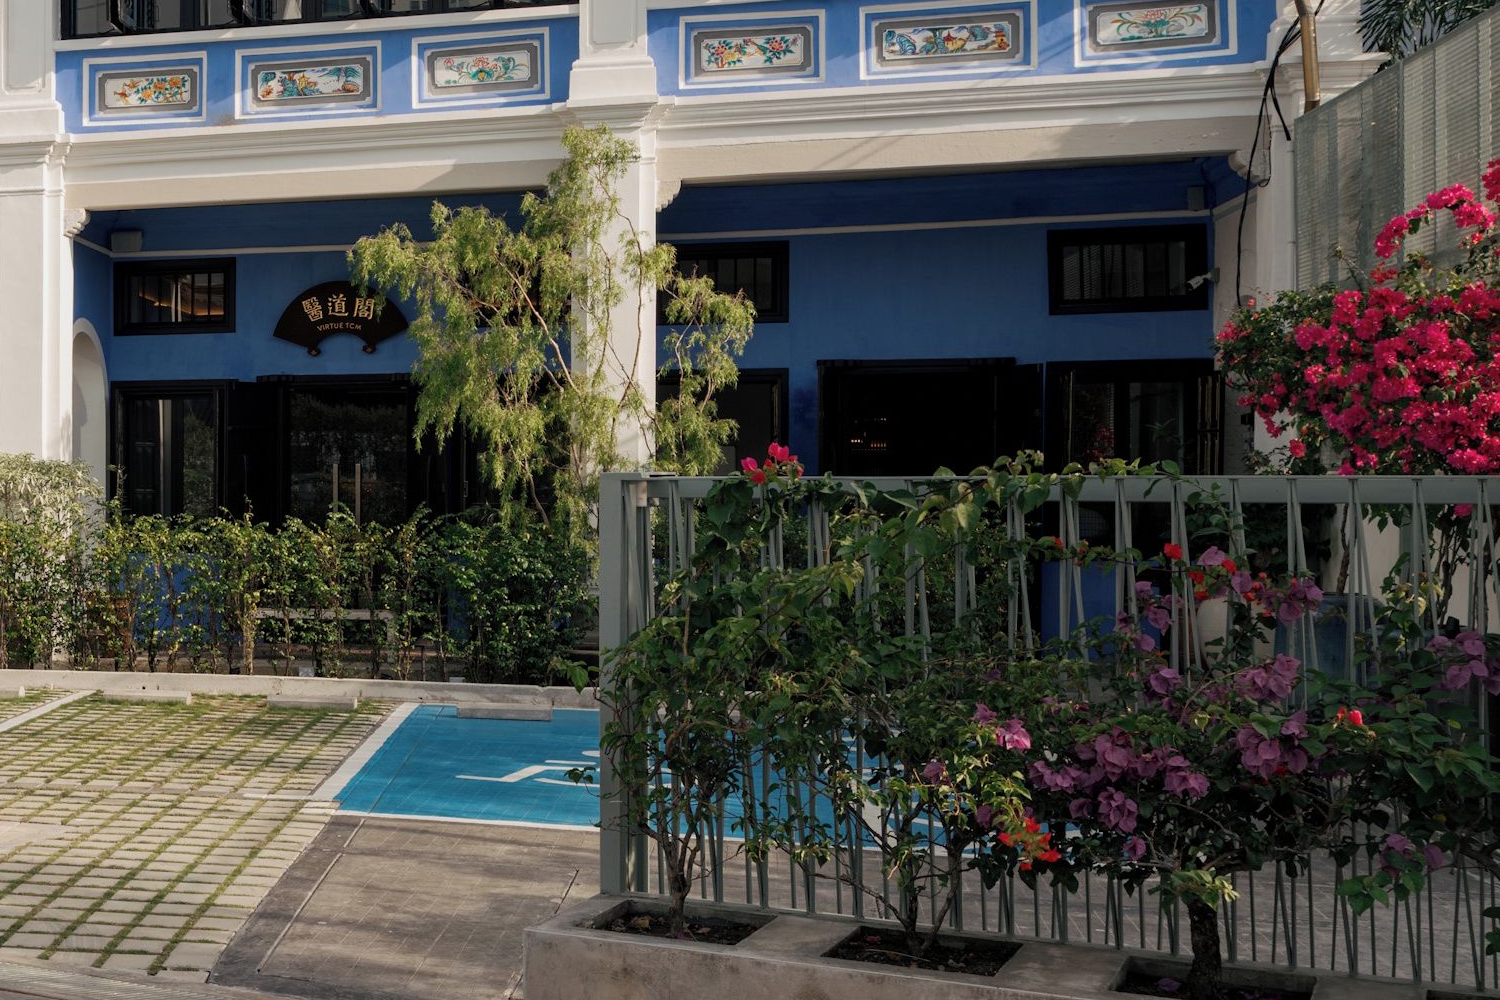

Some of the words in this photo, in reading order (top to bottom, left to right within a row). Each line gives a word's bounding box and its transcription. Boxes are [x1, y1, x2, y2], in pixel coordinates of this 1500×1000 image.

[302, 293, 375, 322] 醫道閣
[317, 322, 344, 331] VIRTUE
[345, 322, 361, 330] TCM
